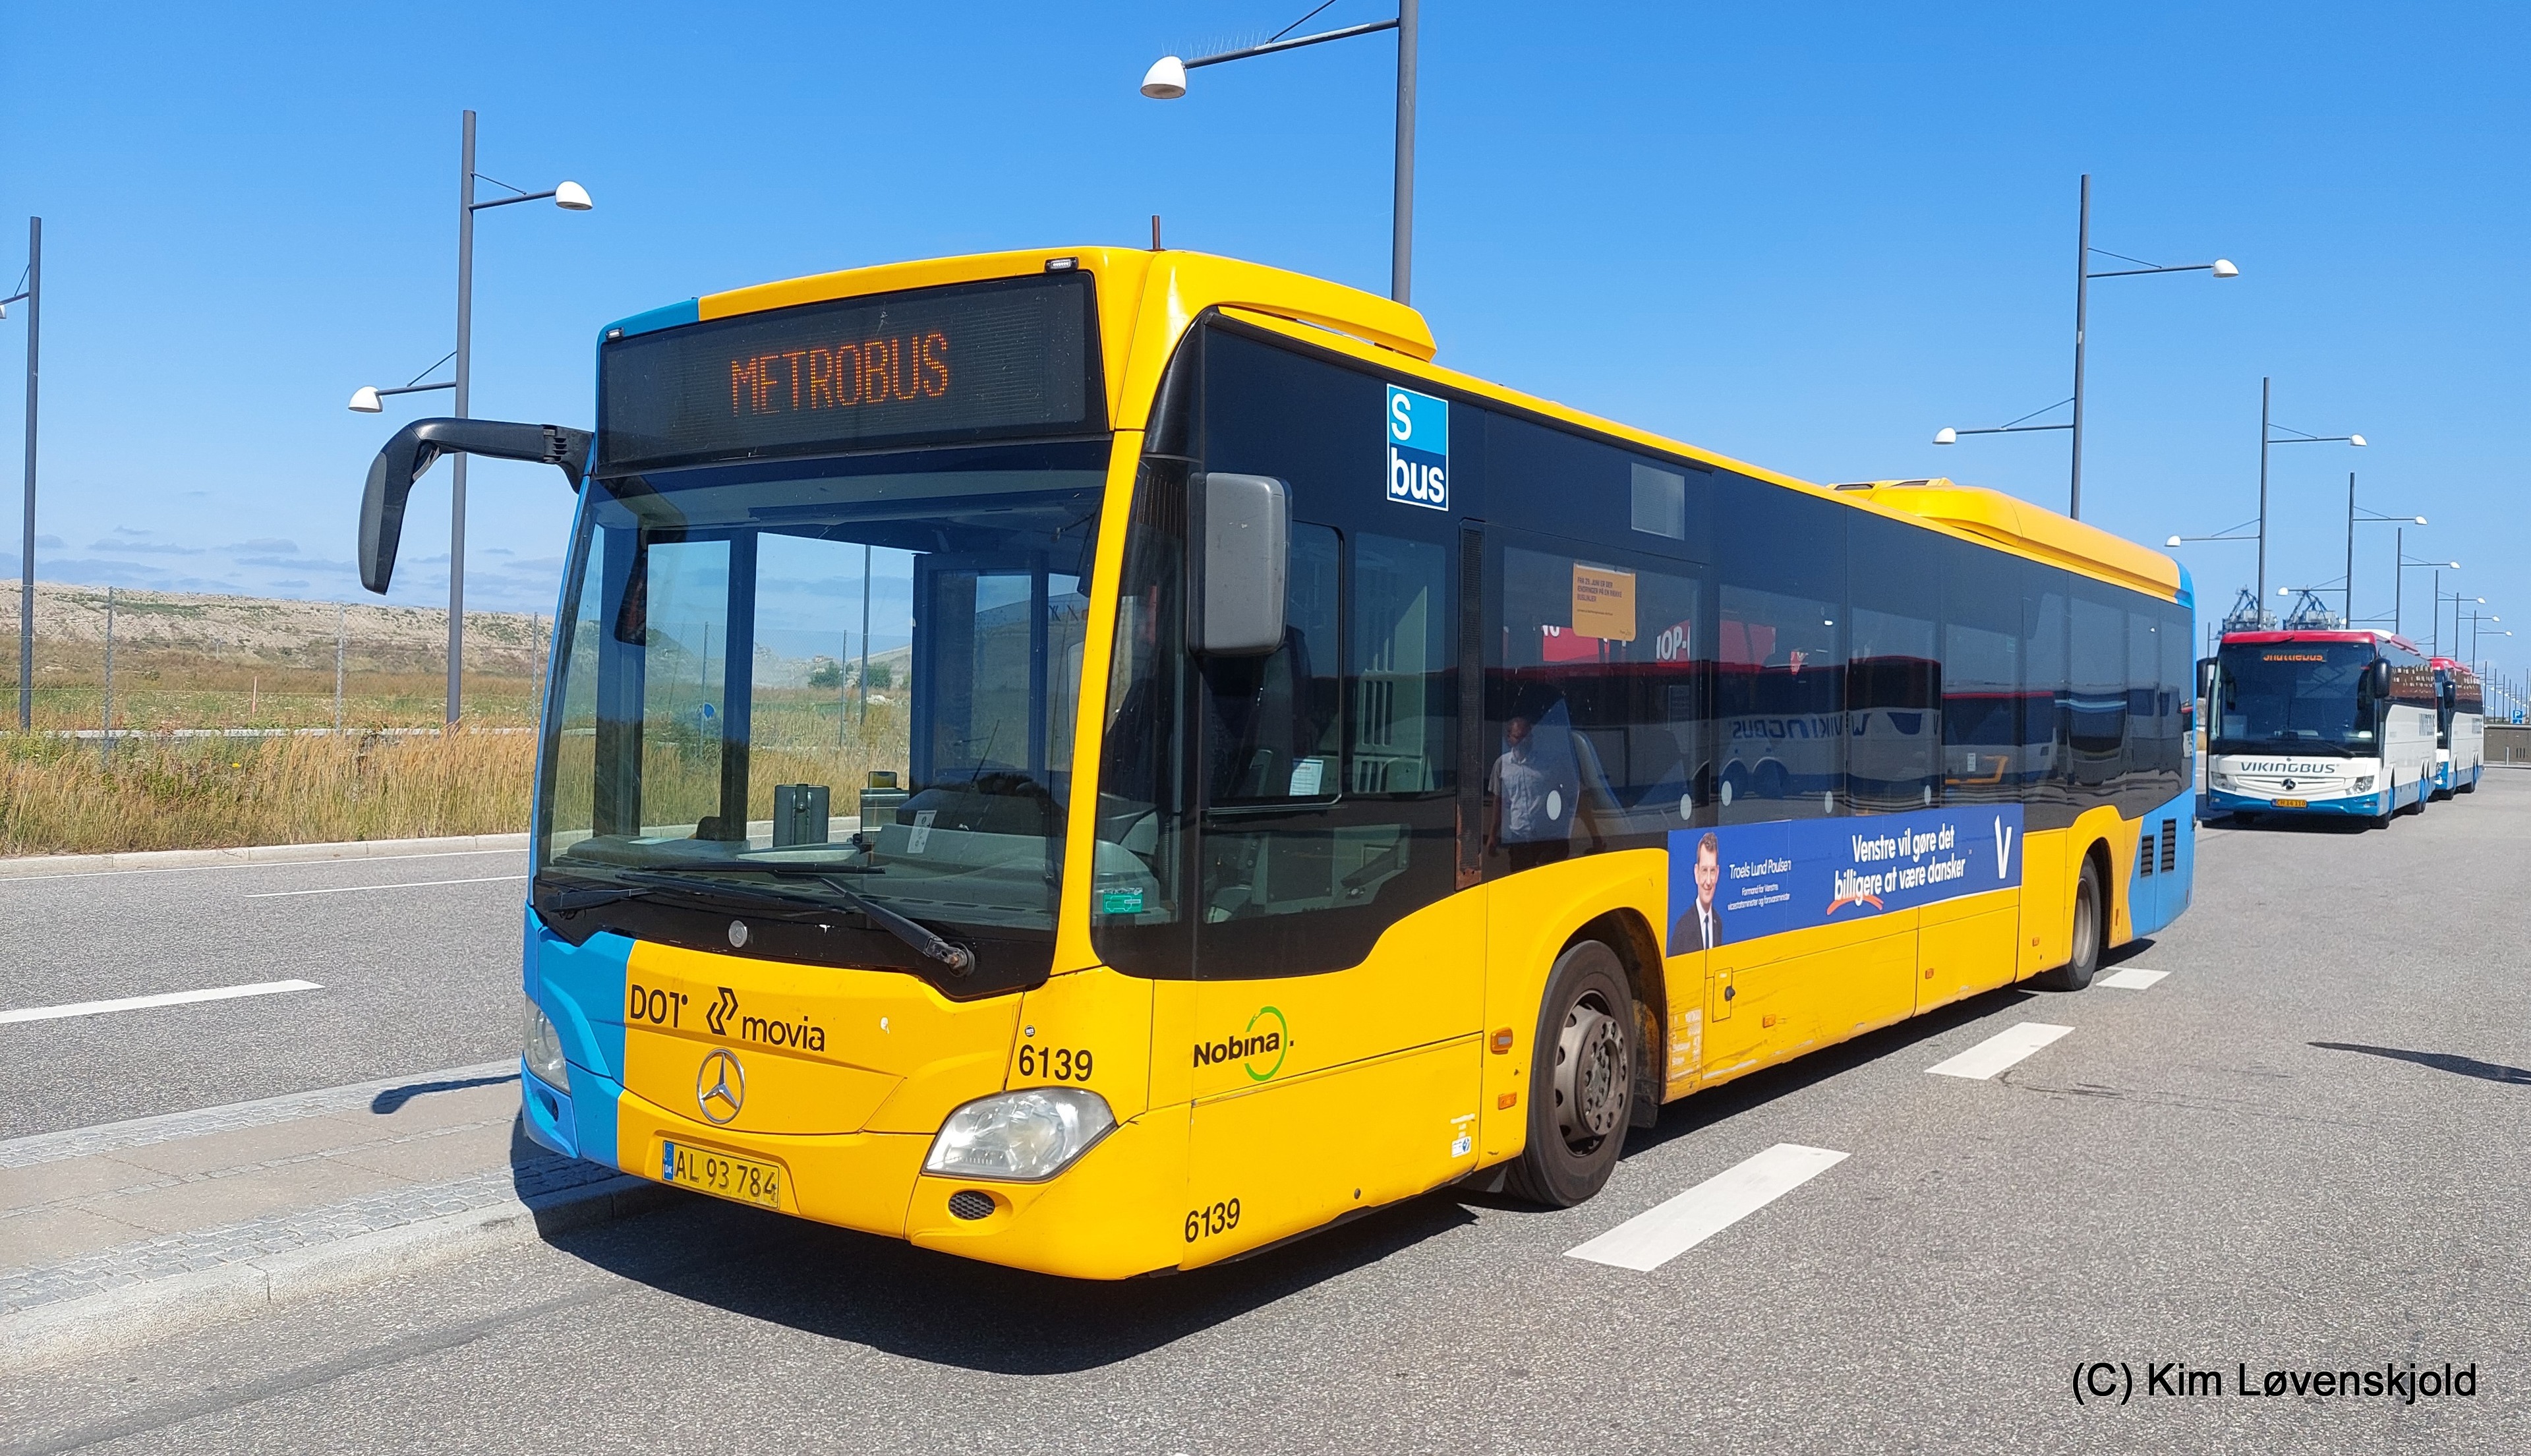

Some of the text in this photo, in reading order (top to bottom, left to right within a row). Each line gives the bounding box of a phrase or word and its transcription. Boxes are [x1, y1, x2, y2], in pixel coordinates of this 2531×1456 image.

[731, 333, 948, 418] METROBUS
[1391, 393, 1412, 440] S
[1391, 448, 1445, 503] bus
[2241, 762, 2335, 773] VIKINGBUS
[1852, 823, 1955, 863] Venstre vil gøre det
[1994, 815, 2012, 879] V
[1730, 858, 1791, 879] Troels Lund Poulsen
[1834, 854, 1965, 906] billigere at være dansker
[742, 1015, 825, 1052] movia
[1019, 1044, 1093, 1082] 6139
[664, 1164, 672, 1175] DK
[675, 1150, 778, 1201] AL 93 784
[1184, 1198, 1240, 1243] 6139
